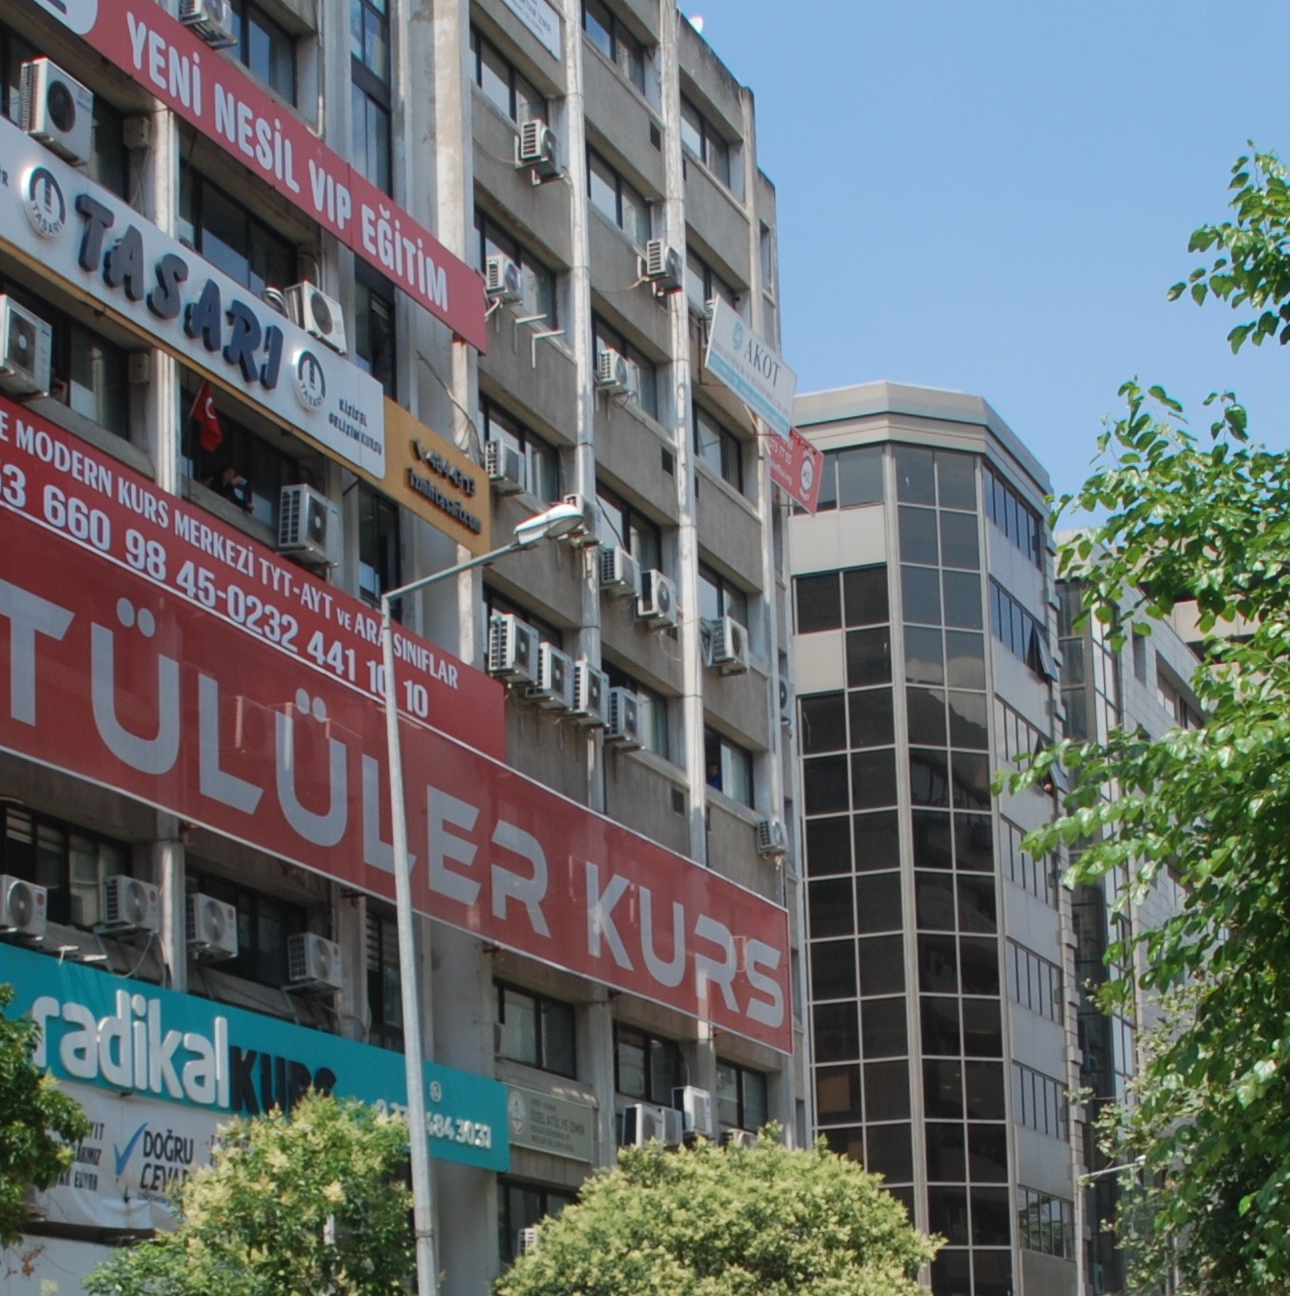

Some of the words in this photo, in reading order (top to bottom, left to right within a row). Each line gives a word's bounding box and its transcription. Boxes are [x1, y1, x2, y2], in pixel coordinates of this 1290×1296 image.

[125, 11, 202, 117] YENİ
[213, 82, 301, 195] NESİL
[308, 157, 353, 230] VIP
[361, 203, 449, 313] EĞİTİM
[75, 193, 284, 391] TASARI
[744, 338, 781, 387] AKOT
[15, 418, 113, 501] MODERN
[118, 478, 169, 530] KURS
[174, 513, 255, 577] MERKEZİ
[258, 556, 333, 620] TYT-AYT
[353, 611, 388, 651] ARA
[392, 632, 459, 691] SINIFLAR
[42, 483, 112, 552] 660
[124, 528, 167, 581] 98
[176, 557, 299, 653] 45-0232
[307, 630, 357, 684] 441
[403, 676, 430, 719] 10
[584, 859, 786, 1030] KURS
[32, 988, 230, 1109] radikal
[143, 1129, 194, 1165] DOĞRU
